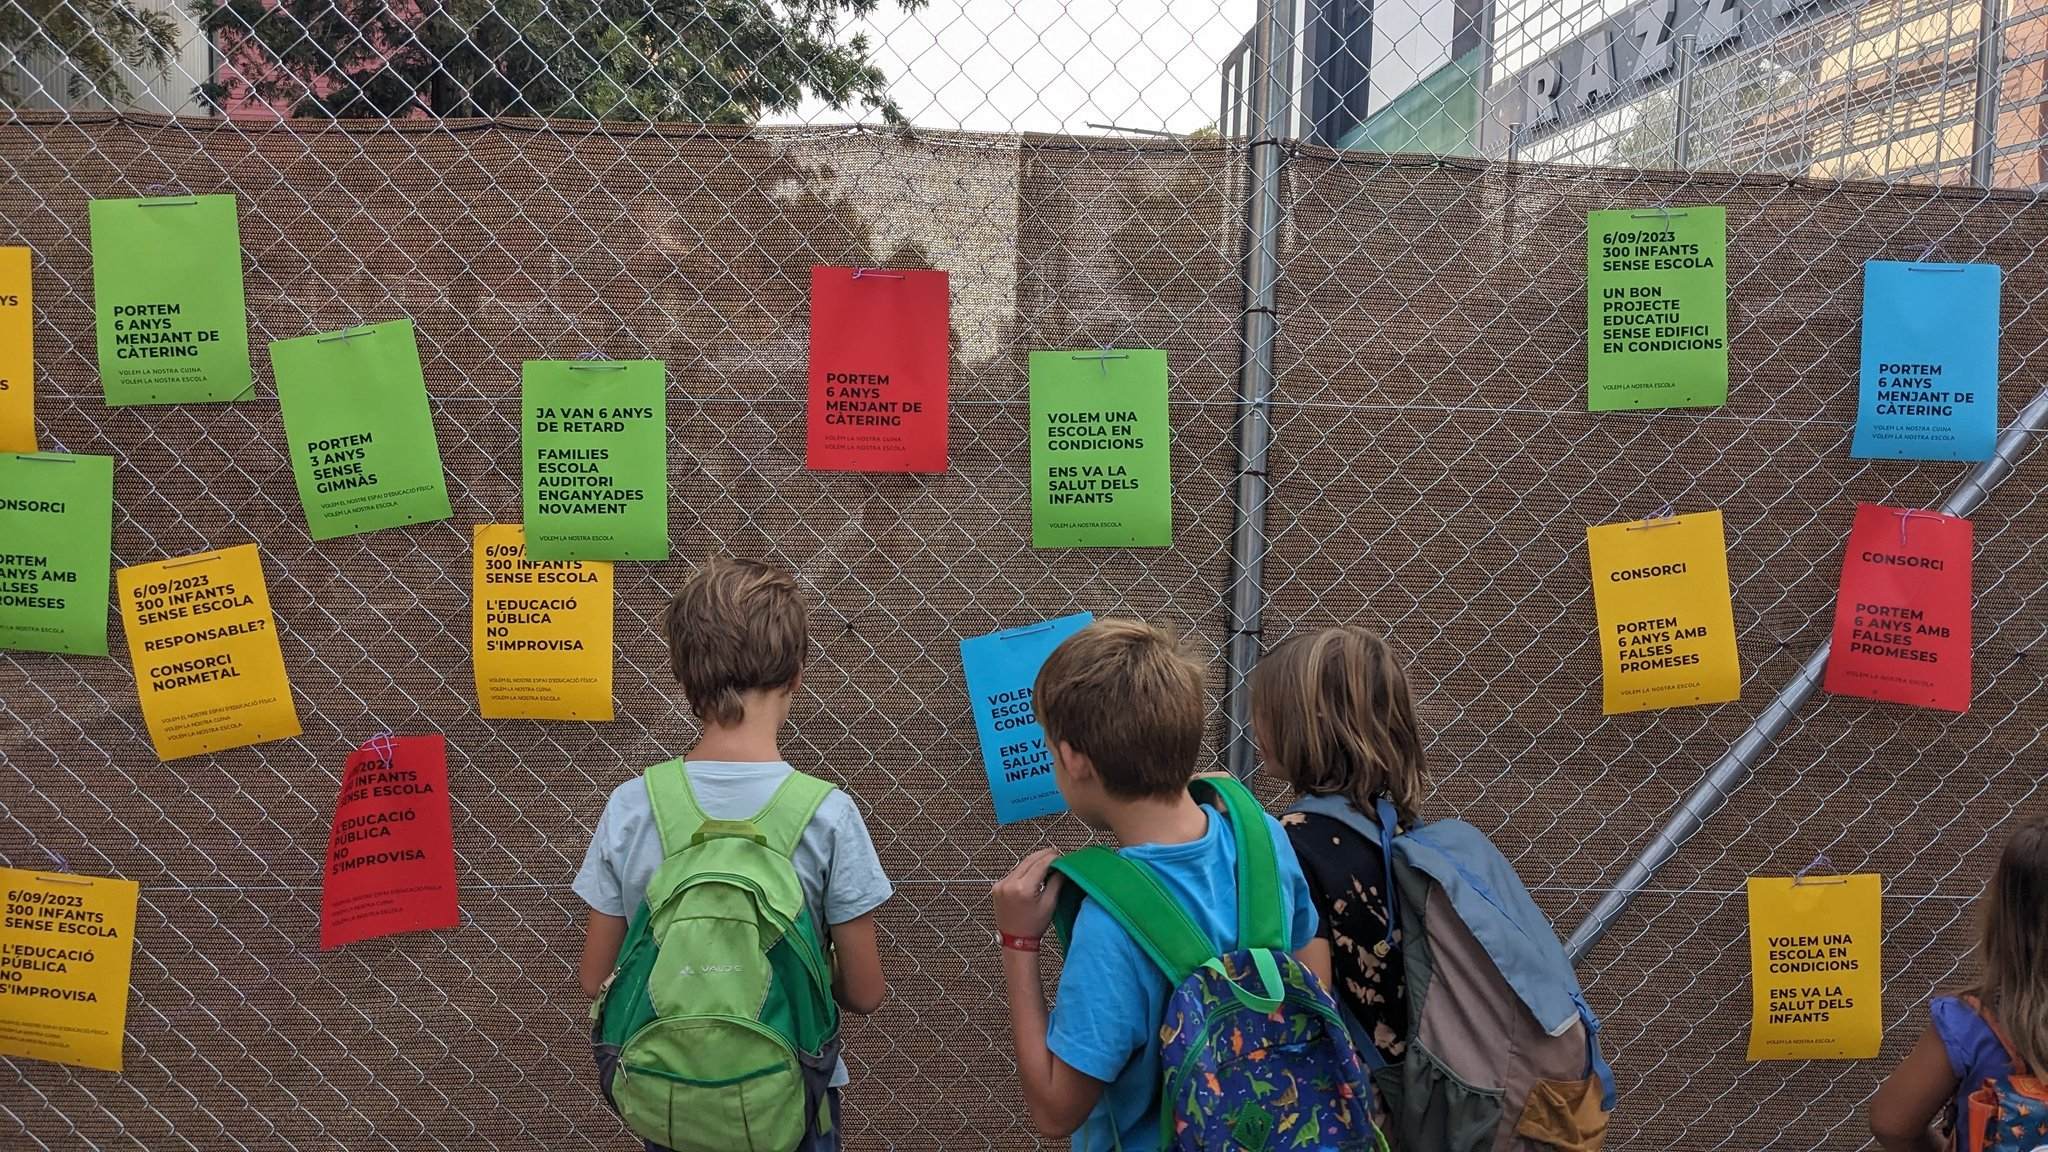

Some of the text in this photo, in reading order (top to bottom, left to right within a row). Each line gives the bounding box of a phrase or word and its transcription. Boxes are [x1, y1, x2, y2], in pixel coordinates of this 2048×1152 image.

[1603, 230, 1675, 245] 6/09/2023
[1603, 244, 1698, 258] 300 INFANTS
[1603, 257, 1713, 271] SENSE ESCOLA
[1604, 287, 1661, 299] UN BON
[114, 304, 180, 317] PORTEM
[1604, 299, 1680, 312] PROJECTE
[115, 318, 172, 331] 6 ANYS
[1604, 313, 1679, 326] EDUCATIU
[116, 331, 219, 345] MENJANT DE
[1603, 325, 1708, 339] SENSE EDIFICI
[117, 345, 198, 359] CÀTERING
[1604, 338, 1722, 353] EN CONDICIONS
[1880, 364, 1941, 375] PORTEM
[827, 373, 889, 385] PORTEM
[1878, 377, 1932, 389] 6 ANYS
[826, 387, 880, 399] 6 ANYS
[1878, 391, 1973, 403] MENJANT DE
[536, 408, 653, 419] JA VAN 6 ANYS
[826, 401, 921, 413] MENJANT DE
[1877, 402, 1952, 416] CÀTERING
[826, 412, 900, 426] CÀTERING
[1048, 411, 1137, 423] VOLEM UNA
[537, 422, 624, 432] DE RETARD
[1048, 425, 1131, 437] ESCOLA EN
[308, 432, 372, 453] PORTEM
[1048, 438, 1144, 451] CONDICIONS
[310, 448, 365, 467] 3 ANYS
[538, 449, 608, 460] FAMILIES
[313, 462, 363, 480] SENSE
[538, 463, 599, 473] ESCOLA
[1049, 466, 1127, 477] ENS VA LA
[317, 473, 377, 493] GIMNÀS
[538, 476, 613, 487] AUDITORI
[1049, 479, 1138, 491] SALUT DELS
[539, 490, 644, 500] ENGANYADES
[1050, 493, 1113, 504] INFANTS
[539, 503, 627, 514] NOVAMENT
[486, 559, 583, 570] 300 INFANTS
[1862, 552, 1943, 570] CONSORCI
[41, 571, 76, 582] AMB
[486, 572, 598, 583] SENSE ESCOLA
[1611, 563, 1686, 582] CONSORCI
[0, 582, 38, 594] LSES
[133, 575, 209, 599] 6/09/2023
[0, 595, 65, 609] OMESES
[136, 584, 235, 612] 300 INFANTS
[487, 597, 577, 610] L'EDUCACIÓ
[138, 595, 253, 625] SENSE ESCOLA
[1856, 604, 1923, 621] PORTEM
[487, 611, 551, 624] PÚBLICA
[487, 627, 508, 637] NO
[1617, 617, 1677, 634] PORTEM
[1855, 616, 1950, 638] 6 ANYS AMB
[144, 620, 265, 652] RESPONSABLE?
[1618, 627, 1707, 647] 6 ANYS AMB
[1853, 629, 1911, 646] FALSES
[487, 640, 583, 651] S'IMPROVISA
[1620, 644, 1673, 660] FALSES
[1851, 642, 1937, 663] PROMESES
[150, 654, 231, 678] CONSORCI
[1621, 654, 1699, 673] PROMESES
[153, 667, 240, 692] NORMETAL
[992, 701, 1033, 719] ESCO
[995, 713, 1037, 731] COND
[1000, 742, 1028, 757] ENS
[1003, 750, 1048, 770] SALUT
[355, 771, 417, 786] INFANTS
[373, 784, 433, 797] ESCOLA
[8, 890, 82, 907] 6/09/2023
[6, 904, 103, 923] 300 INFANTS
[5, 917, 118, 938] SENSE ESCOLA
[1769, 934, 1852, 947] VOLEM UNA
[3, 944, 94, 962] L'EDUCACIÓ
[1770, 947, 1847, 960] ESCOLA EN
[1, 956, 66, 973] PÚBLICA
[1770, 960, 1858, 973] CONDICIONS
[0, 970, 22, 981] NO
[0, 983, 97, 1002] S'IMPROVISA
[1770, 986, 1842, 999] ENS VA LA
[1770, 998, 1853, 1012] SALUT DELS
[1770, 1012, 1829, 1024] INFANTS
